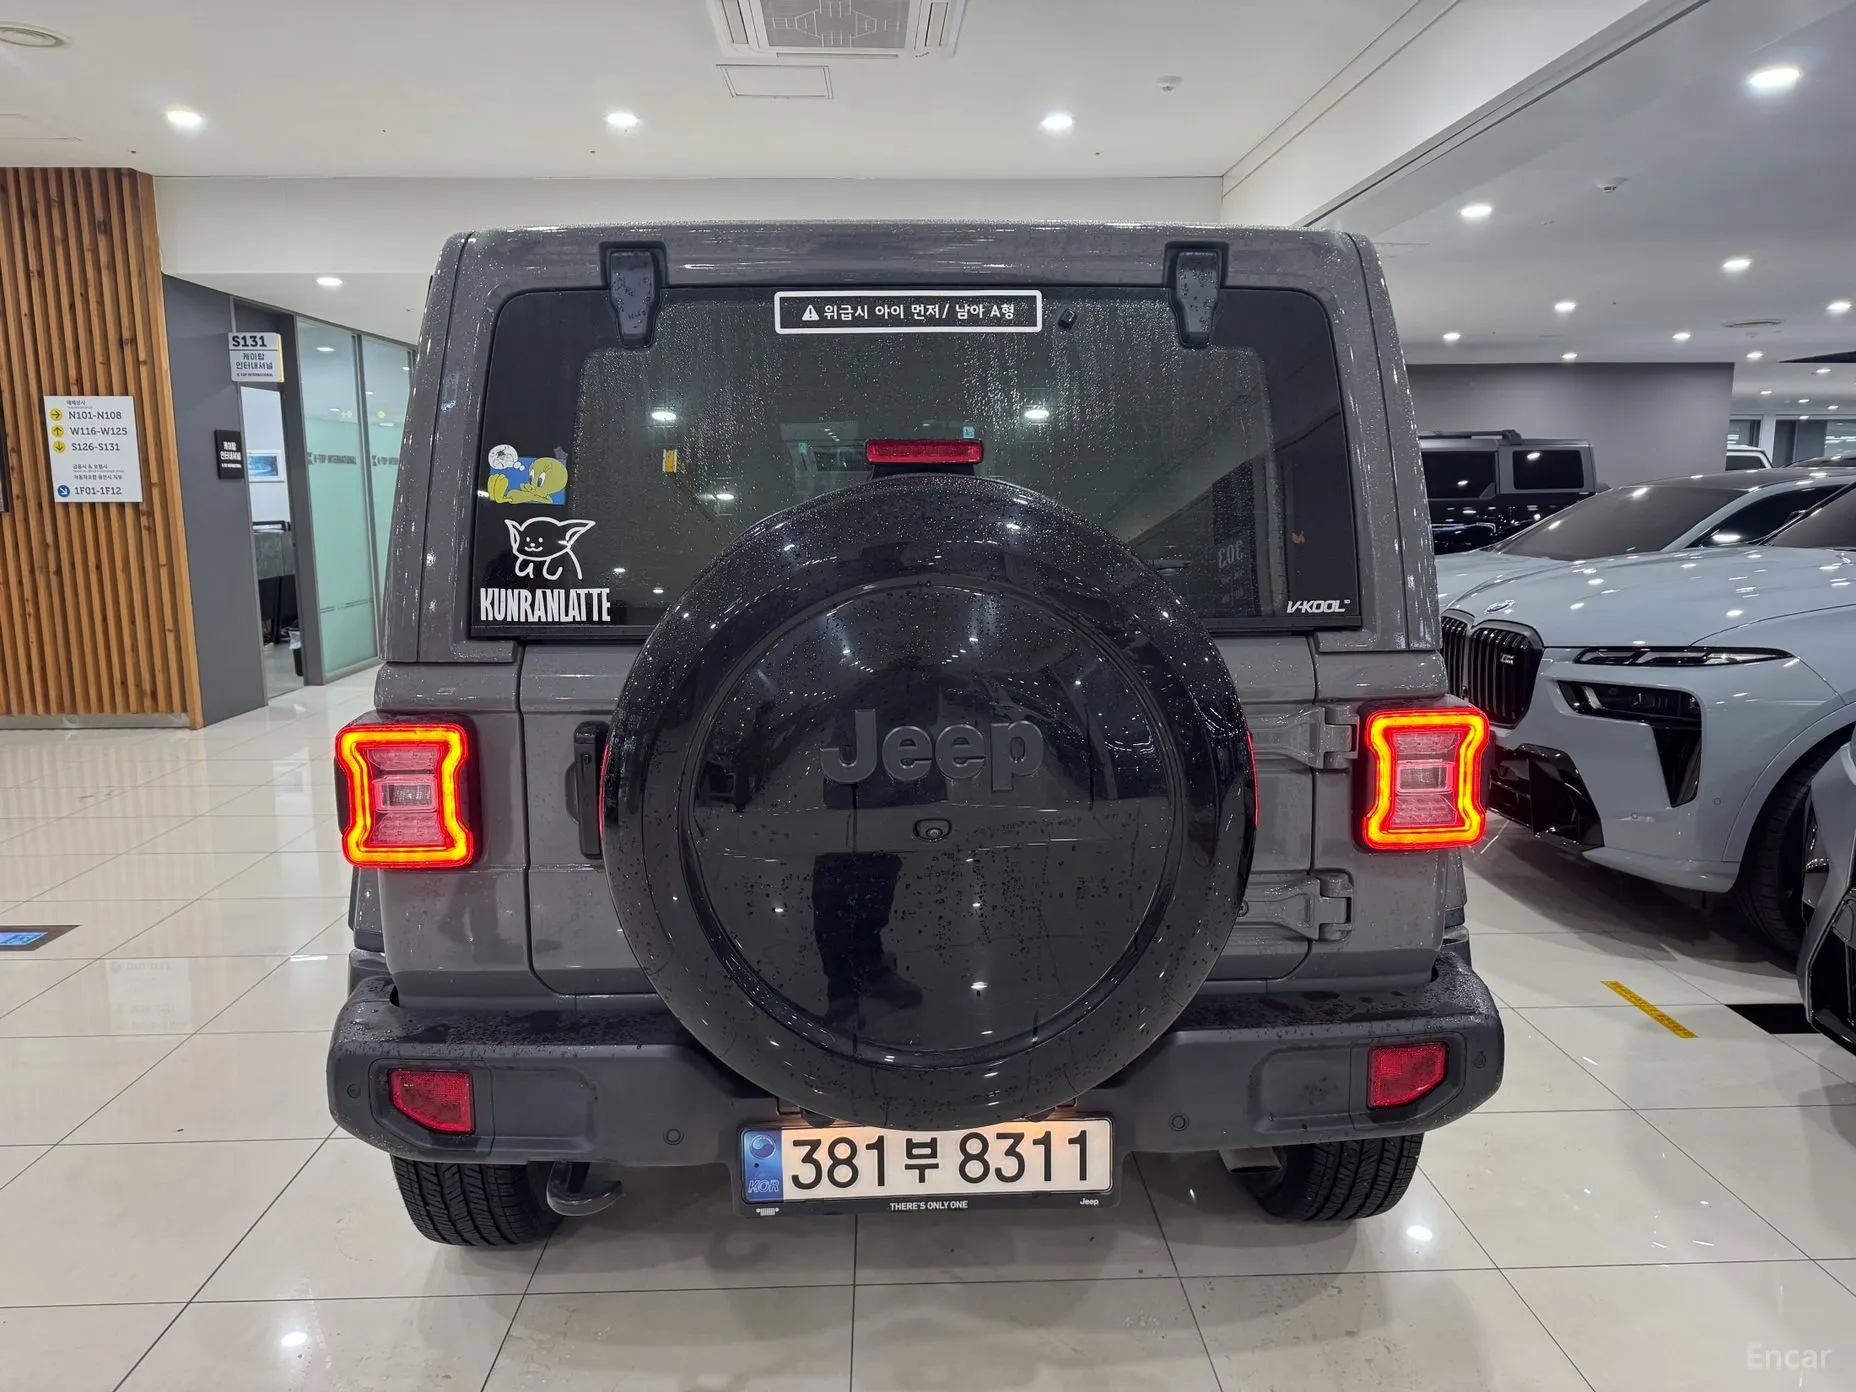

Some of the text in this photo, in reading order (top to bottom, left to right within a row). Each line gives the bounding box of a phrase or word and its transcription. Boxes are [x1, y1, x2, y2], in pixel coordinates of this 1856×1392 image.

[823, 304, 869, 320] 위급시
[875, 304, 904, 320] 아이
[955, 303, 985, 319] 남아
[989, 303, 1015, 320] A형
[231, 335, 267, 347] S131
[235, 361, 273, 370] 인터내셔널
[68, 411, 122, 420] N101-N108
[69, 427, 128, 436] W116-W125
[71, 443, 121, 451] S126-S131
[74, 486, 122, 495] 1F01-1F12
[480, 587, 611, 622] KUNRANLATTE
[820, 708, 1044, 791] Jeep
[958, 1129, 1088, 1184] 8311
[748, 1179, 780, 1193] KOR
[889, 1200, 968, 1211] THERE'S ONLY ONE
[1079, 1197, 1100, 1207] Jeep
